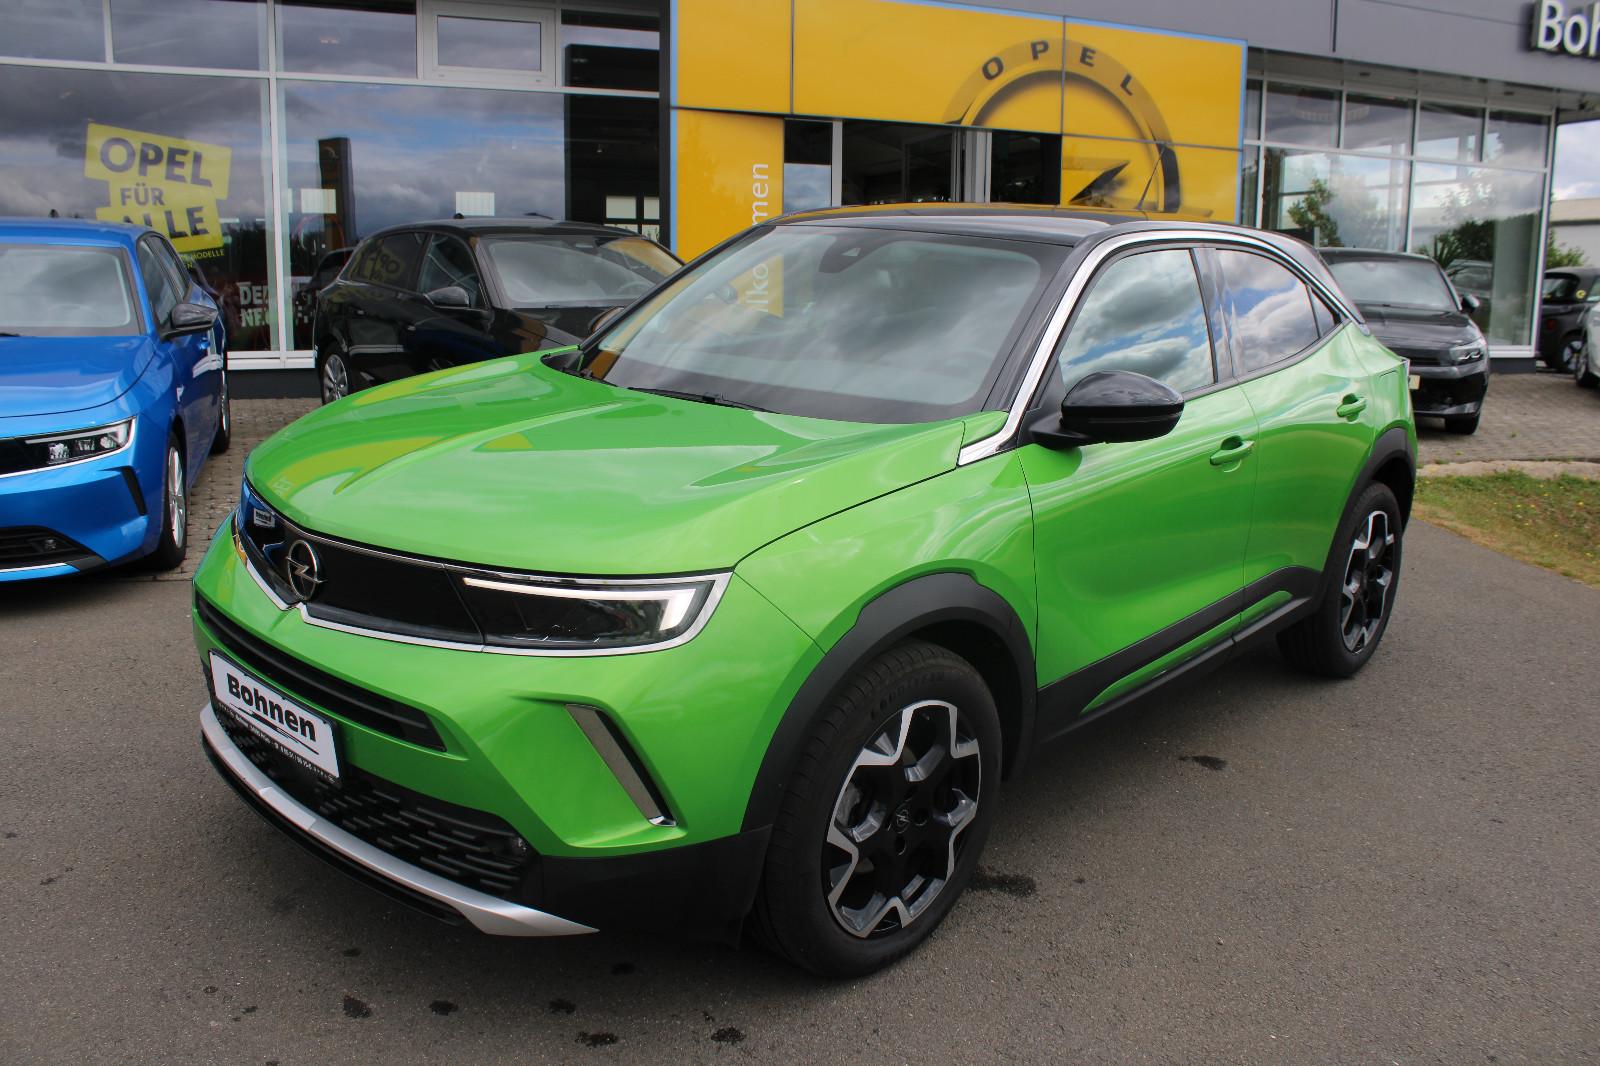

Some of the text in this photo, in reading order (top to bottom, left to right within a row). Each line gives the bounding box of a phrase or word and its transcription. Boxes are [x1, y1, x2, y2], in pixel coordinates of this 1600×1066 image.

[981, 39, 1133, 97] OPEL
[100, 137, 213, 187] OPEL
[120, 182, 165, 206] FÜR
[226, 672, 316, 742] Bohnen
